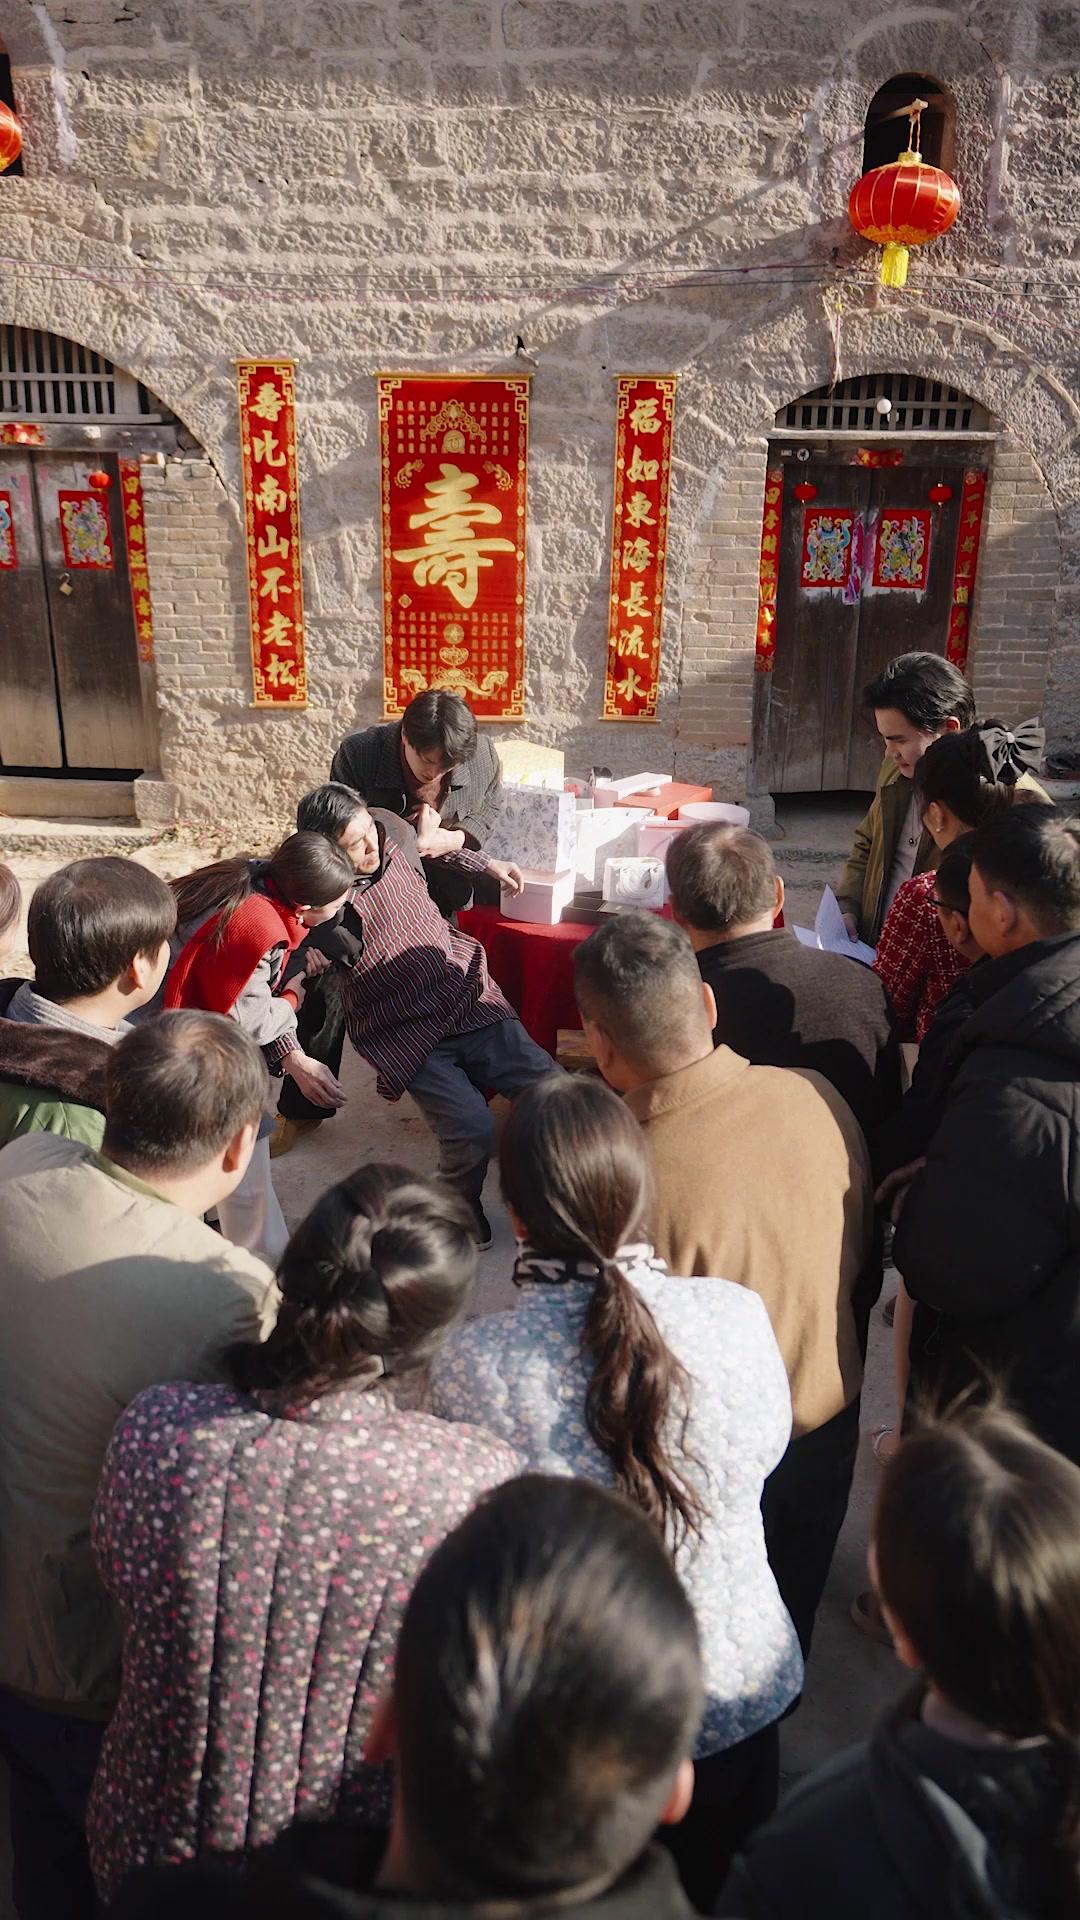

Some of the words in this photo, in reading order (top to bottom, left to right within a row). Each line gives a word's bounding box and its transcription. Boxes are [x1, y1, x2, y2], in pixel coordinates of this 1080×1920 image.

[617, 397, 661, 701] 福如東海長流水
